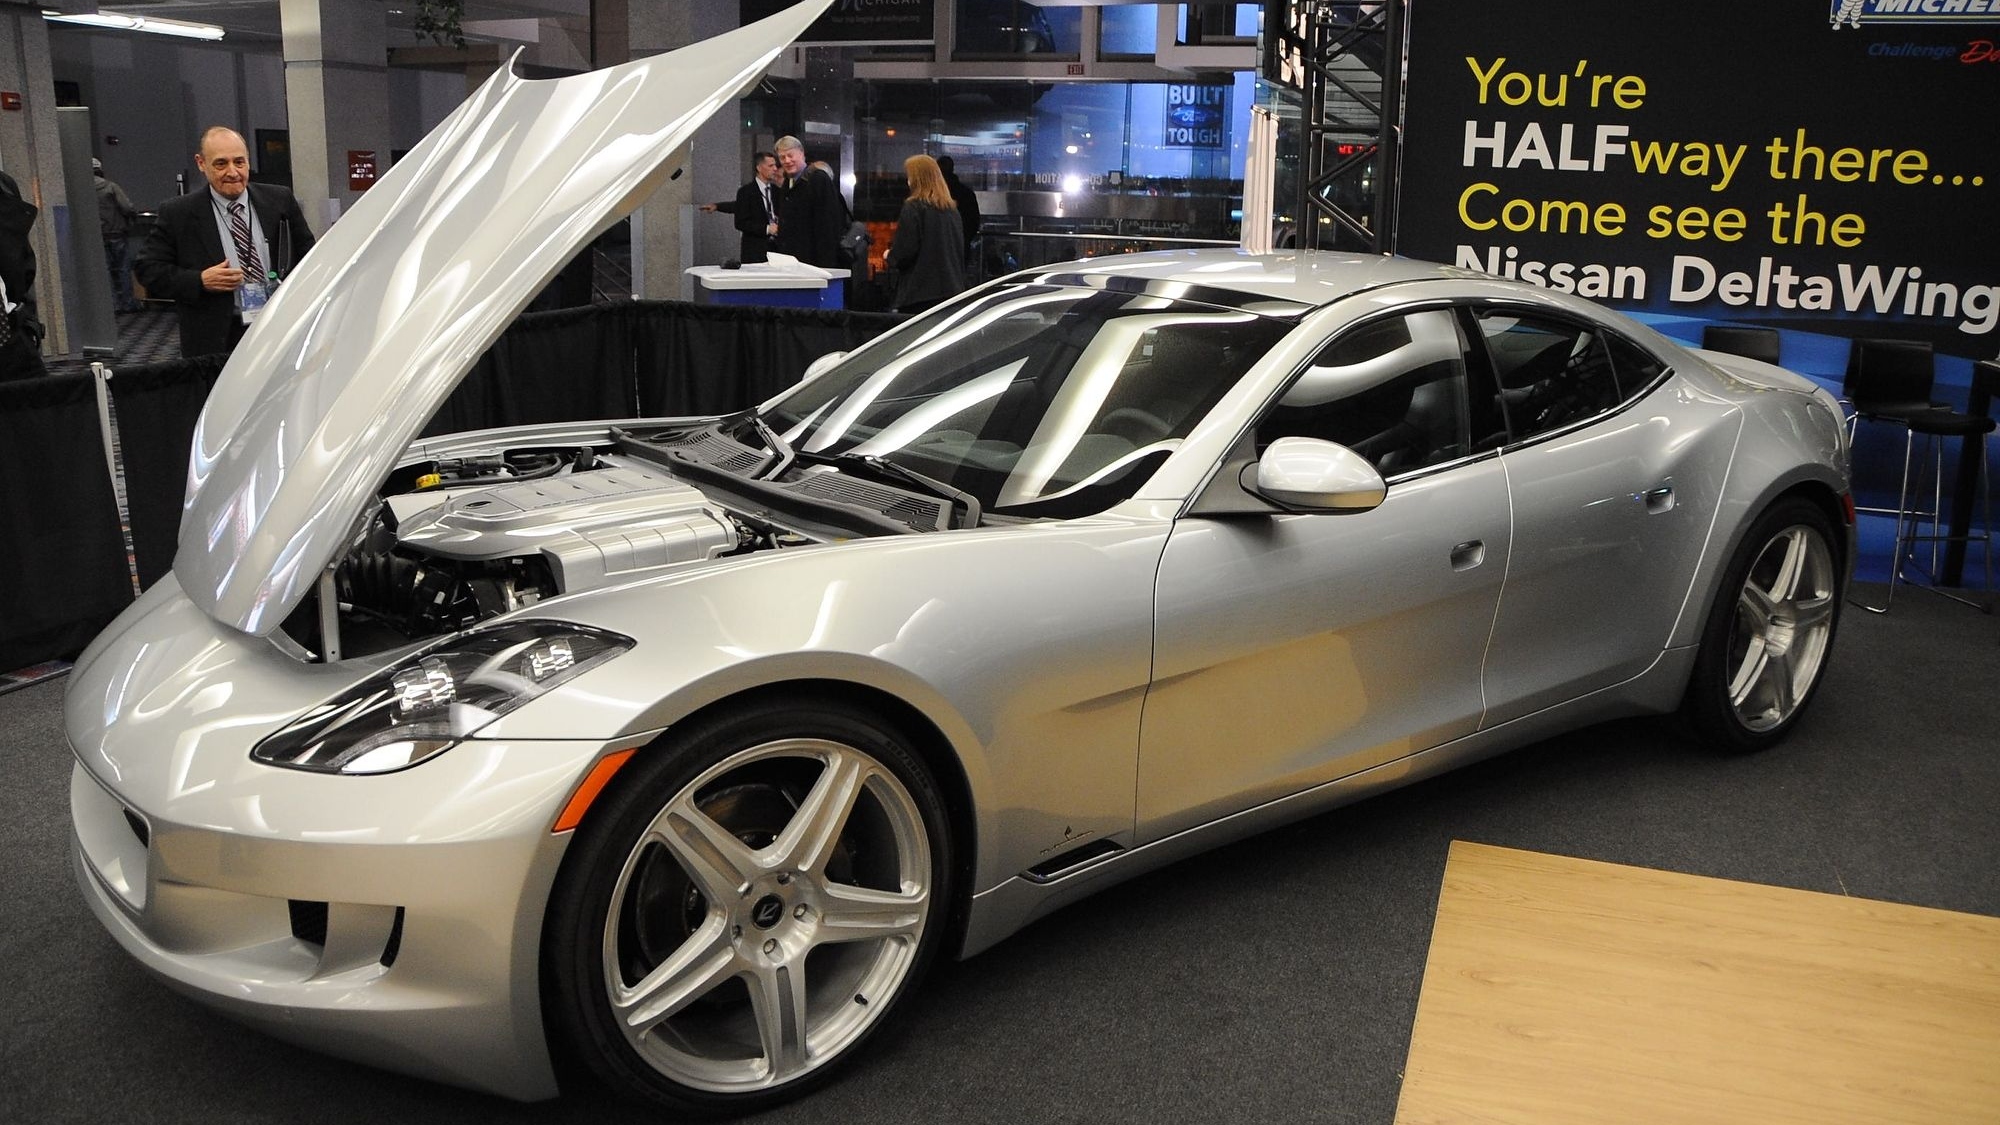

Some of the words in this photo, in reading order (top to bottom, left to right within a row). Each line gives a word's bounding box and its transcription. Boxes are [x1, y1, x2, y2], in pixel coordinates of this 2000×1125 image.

[1867, 41, 1957, 59] Challenge
[1169, 85, 1223, 105] BUILT
[1168, 128, 1220, 143] TOUGH
[1765, 128, 1984, 187] there...
[1458, 183, 1626, 236] Come
[1646, 205, 1747, 241] see
[1767, 194, 1865, 247] the
[1456, 245, 1646, 300] Nissan
[1669, 255, 2000, 334] DeltaWing
